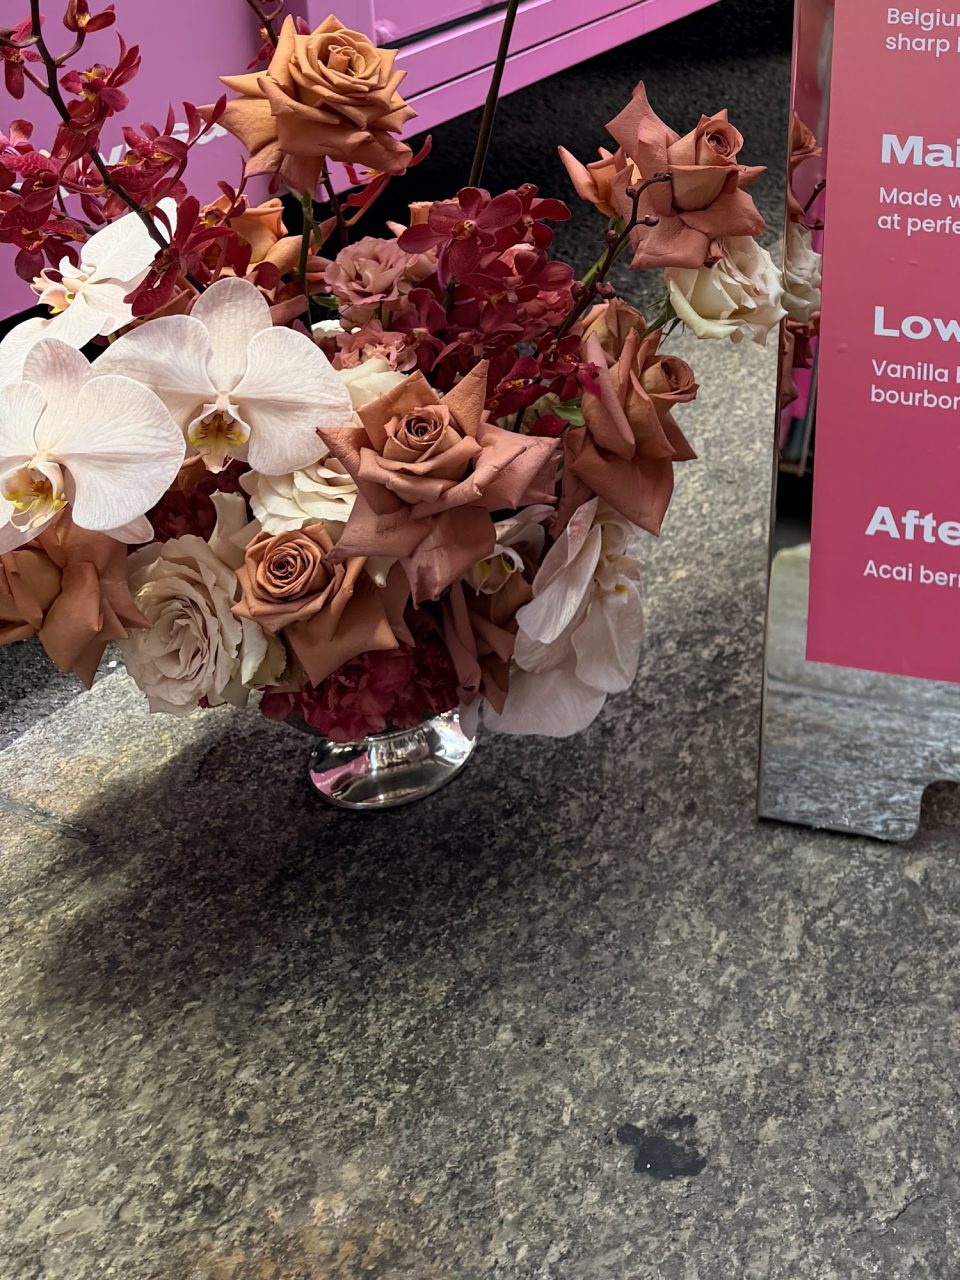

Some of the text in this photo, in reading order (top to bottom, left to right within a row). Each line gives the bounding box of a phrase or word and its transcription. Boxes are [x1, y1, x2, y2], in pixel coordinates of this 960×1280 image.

[885, 32, 951, 58] sharp
[879, 186, 943, 208] Made
[877, 212, 902, 230] at
[871, 358, 949, 383] Vanilla
[863, 559, 913, 583] Acai
